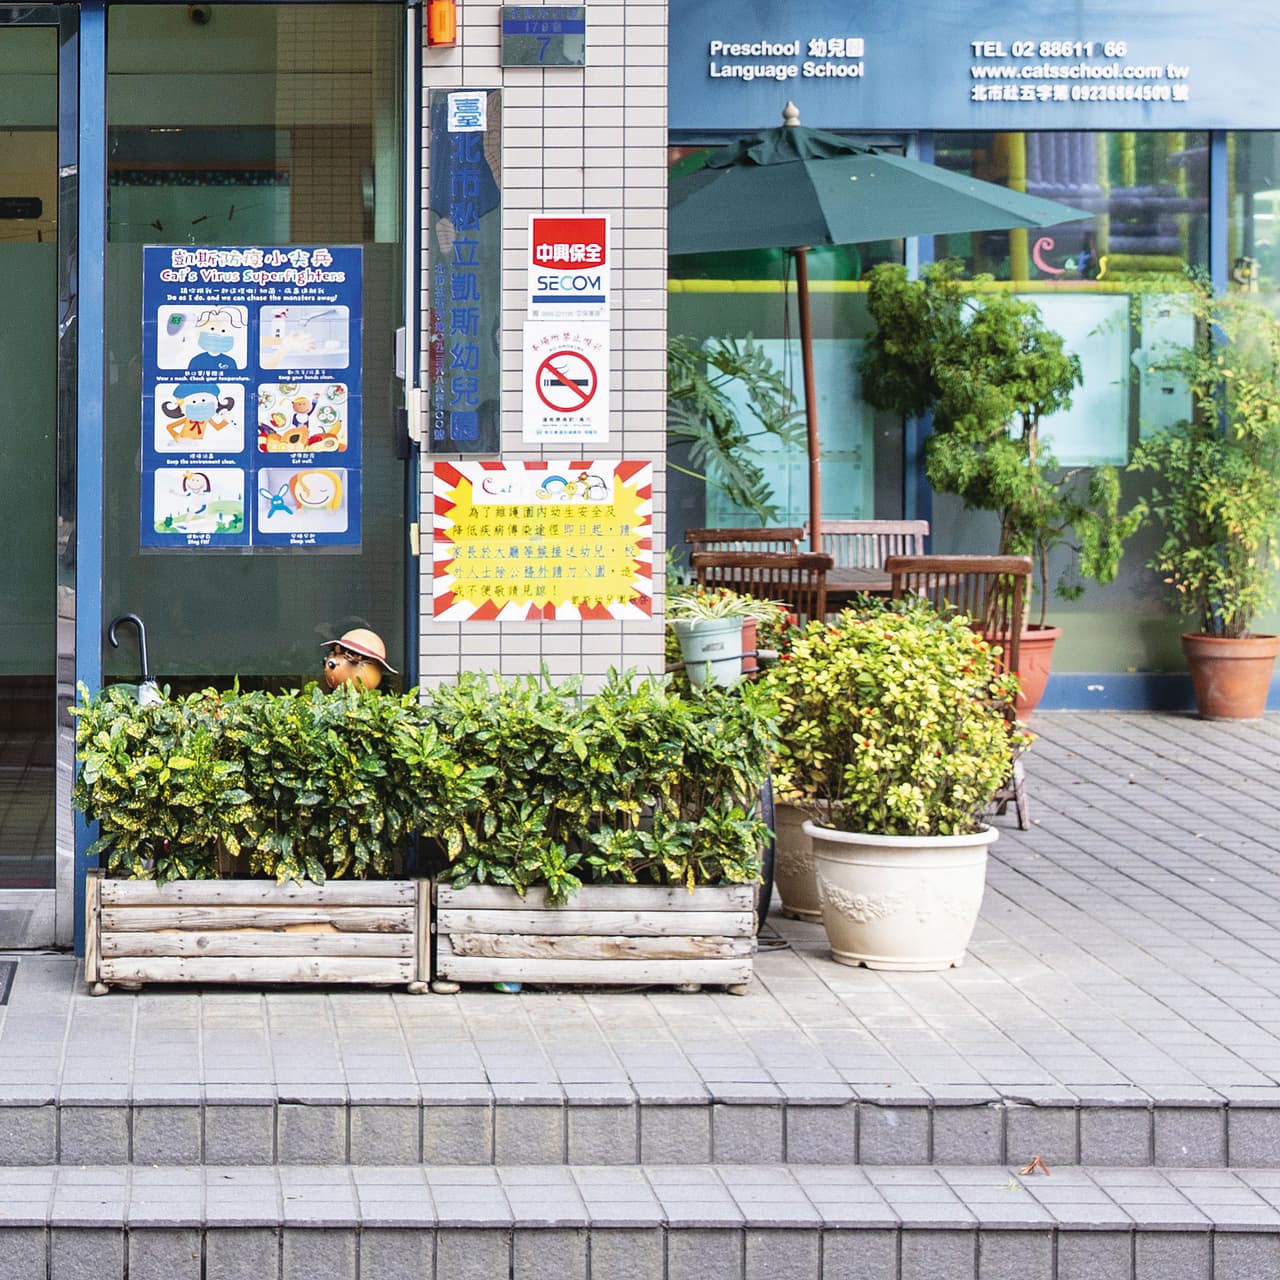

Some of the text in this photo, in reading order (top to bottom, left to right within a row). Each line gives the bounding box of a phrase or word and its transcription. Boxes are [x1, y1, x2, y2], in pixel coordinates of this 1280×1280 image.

[535, 36, 552, 64] 7
[710, 40, 800, 56] Preschool
[971, 41, 1008, 57] TEL
[1011, 41, 1035, 57] 02
[710, 61, 864, 81] Language School
[971, 63, 1163, 79] www.catsschool.com
[535, 243, 603, 263] 中興保全
[160, 267, 346, 287] Cat's Virus Superfighters
[537, 275, 601, 291] SECOM
